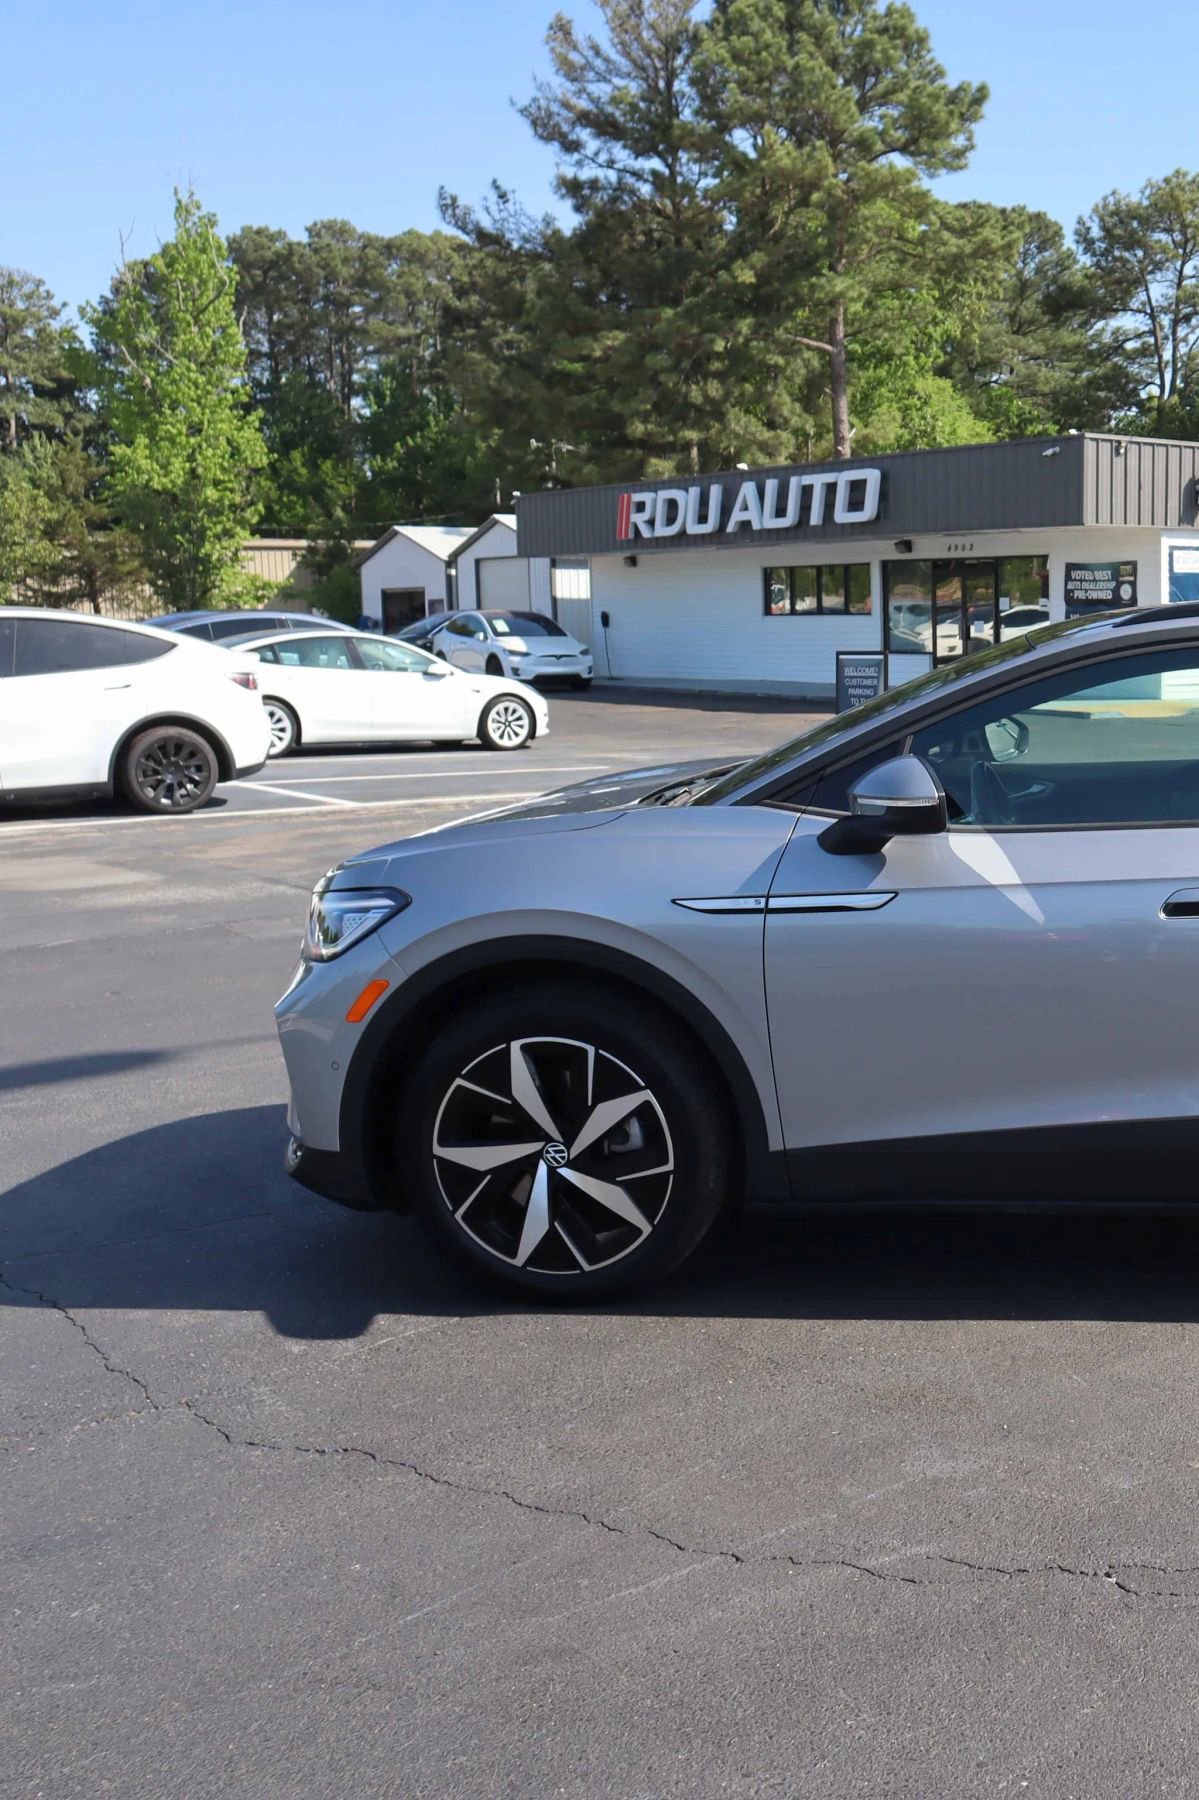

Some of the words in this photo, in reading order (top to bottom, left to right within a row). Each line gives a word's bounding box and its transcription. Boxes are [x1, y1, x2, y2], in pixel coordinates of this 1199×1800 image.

[616, 483, 723, 541] RDU
[726, 468, 881, 534] AUTO
[1070, 570, 1093, 580] VOTED
[1094, 570, 1112, 580] BEST
[1067, 581, 1080, 590] AUTO
[1081, 581, 1117, 590] DEALERSHIP
[1073, 590, 1113, 600] PRE-OWNED
[844, 666, 878, 676] WELCOME!
[844, 678, 878, 686] CUSTOMER
[848, 688, 874, 696] PARKING
